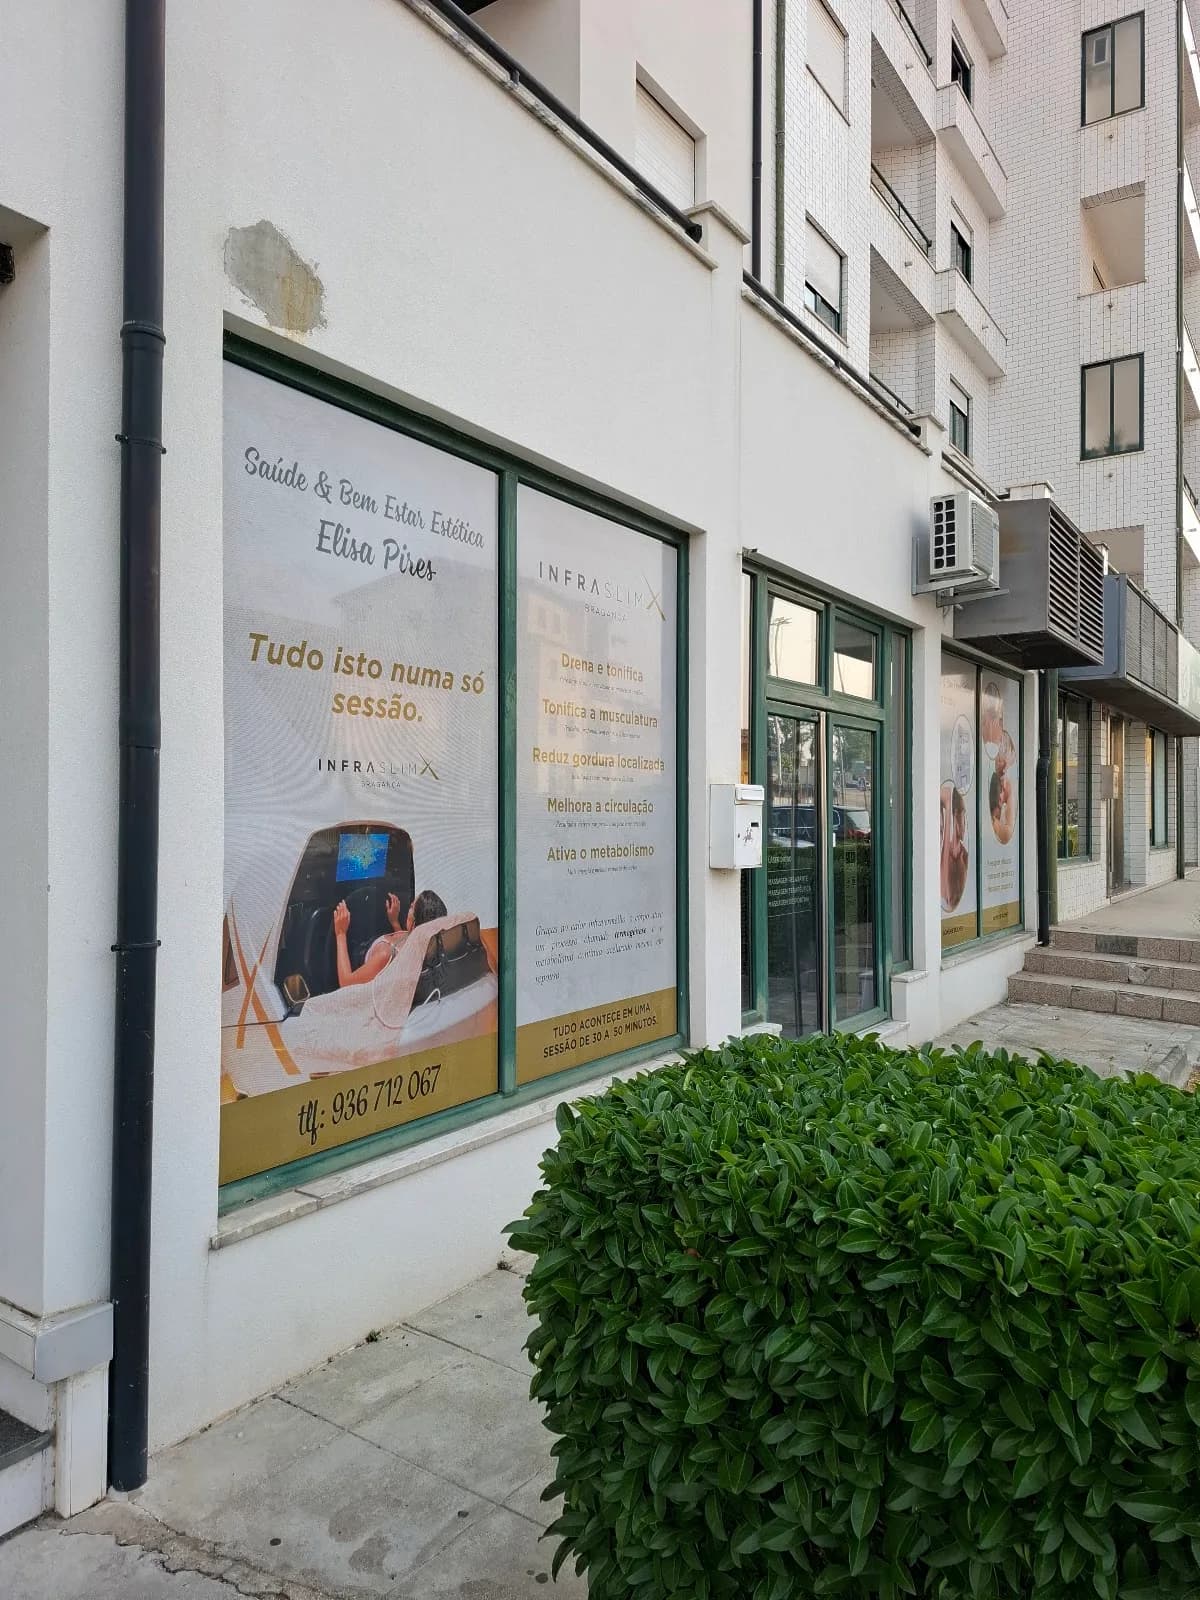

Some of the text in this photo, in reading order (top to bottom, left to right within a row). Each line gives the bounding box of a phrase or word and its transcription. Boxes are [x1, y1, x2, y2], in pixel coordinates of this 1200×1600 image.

[244, 446, 485, 549] Saúde & Bem Estar Estética
[315, 518, 437, 582] Elisa Pires
[248, 632, 485, 695] Tudo isto numa só
[561, 652, 644, 682] Drena e tonifica
[331, 692, 423, 722] sessão.
[542, 698, 658, 728] Tonifica a musculatura
[532, 747, 665, 771] Reduz gordura localizada
[547, 797, 654, 816] Melhora a circulação
[547, 843, 655, 861] Ativa o metabolismo
[553, 1022, 577, 1039] TUDO
[622, 1007, 633, 1019] EM
[634, 1002, 651, 1016] UMA
[543, 1036, 577, 1058] SESSÃO
[579, 1034, 590, 1048] DE
[592, 1031, 602, 1044] 30
[603, 1029, 610, 1041] A
[613, 1025, 623, 1037] 50
[298, 1063, 442, 1145] tlf: 936 712 067
